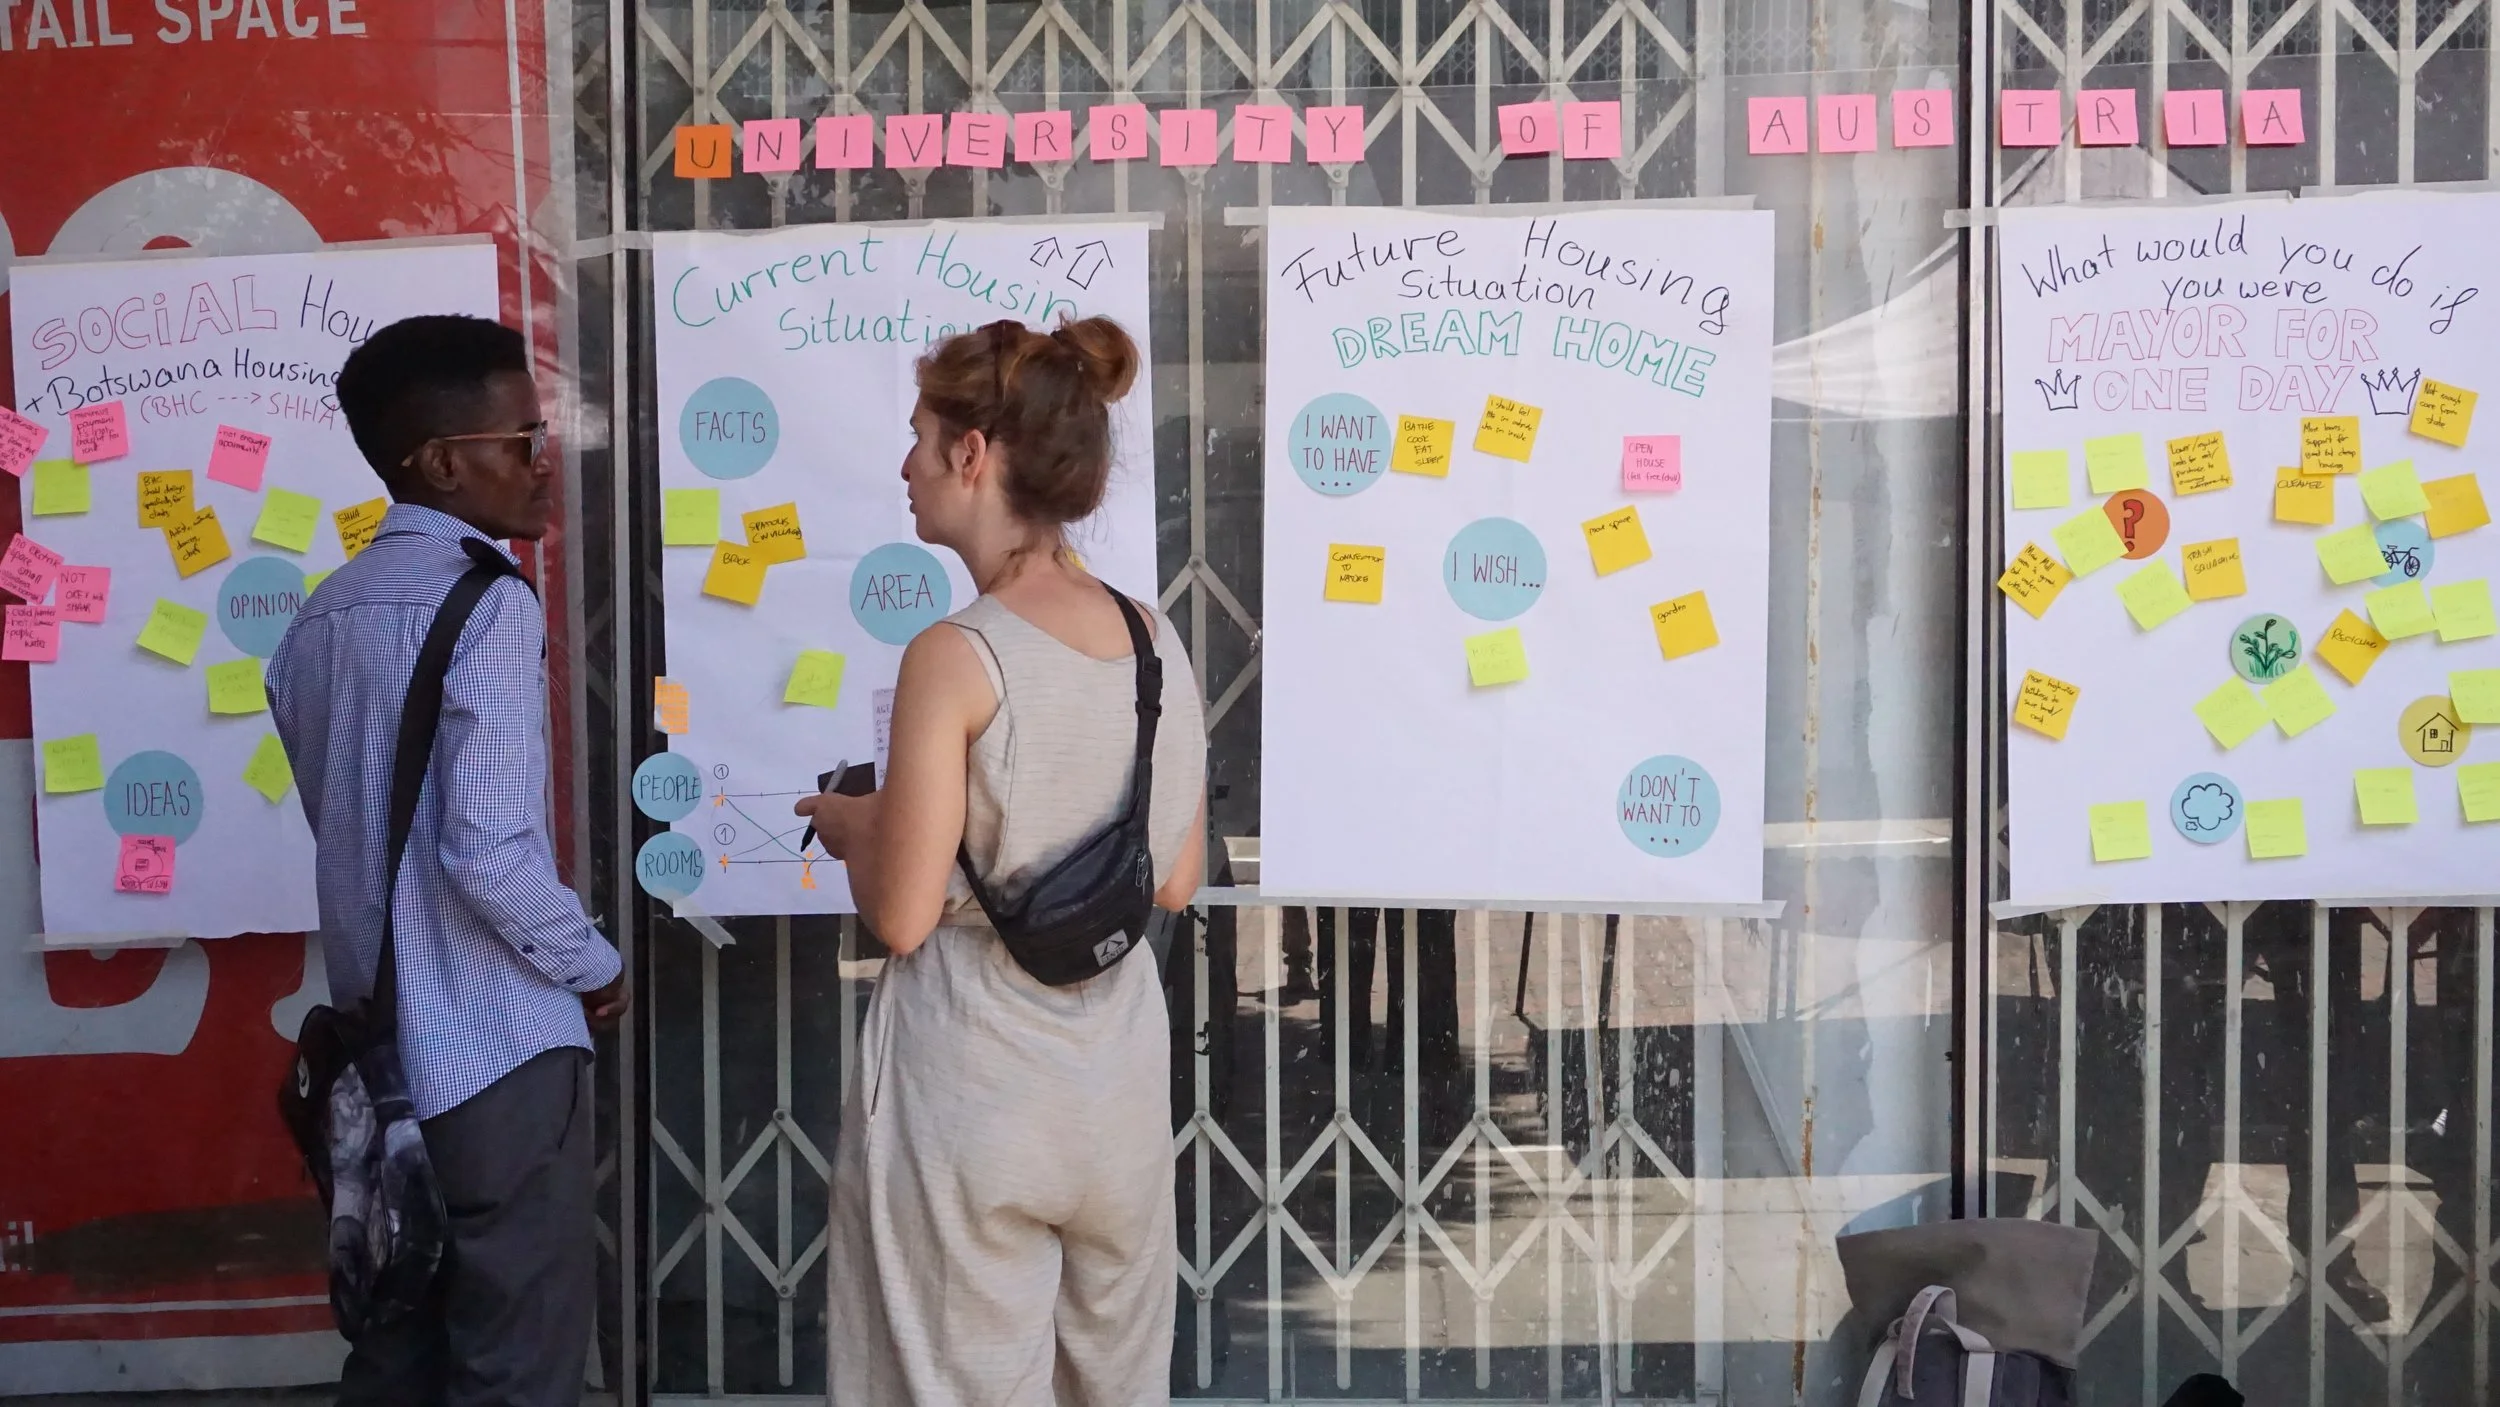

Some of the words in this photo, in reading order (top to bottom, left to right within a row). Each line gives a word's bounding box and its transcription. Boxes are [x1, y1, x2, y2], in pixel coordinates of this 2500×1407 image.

[157, 0, 367, 45] SPACE
[690, 113, 1347, 170] UNIVERSITY
[1518, 113, 1602, 151] OF
[673, 230, 885, 328] Current
[916, 228, 1078, 324] Housin
[1281, 227, 1466, 303] Future
[1523, 217, 1730, 336] Housing
[1397, 263, 1596, 310] Situation
[2020, 233, 2116, 298] What
[2136, 214, 2248, 263] would
[2279, 236, 2354, 274] you
[2371, 244, 2423, 298] do
[2428, 284, 2479, 335] if
[300, 273, 374, 345] Hou
[2161, 275, 2224, 315] you
[2239, 279, 2329, 304] were
[779, 297, 971, 351] Situatio
[2047, 303, 2248, 364] MAYOR
[2273, 306, 2380, 362] FOR
[1332, 309, 1523, 369] DREAM
[1553, 315, 1716, 398] HOME
[2093, 366, 2210, 413] ONE
[2237, 365, 2356, 414] DAY
[695, 410, 767, 444] FACTS
[1304, 414, 1311, 439] I
[1320, 413, 1377, 441] WANT
[1302, 447, 1325, 471] TO
[1334, 447, 1381, 474] HAVE
[1628, 442, 1654, 455] OPEN
[1635, 457, 1666, 469] HOUSE
[860, 573, 935, 613] AREA
[125, 781, 191, 818] IDEAS
[639, 773, 702, 802] PEOPLE
[1639, 767, 1701, 803] DON'T
[1622, 802, 1674, 826] WANT
[1680, 804, 1702, 827] TO
[644, 848, 704, 879] ROOMS
